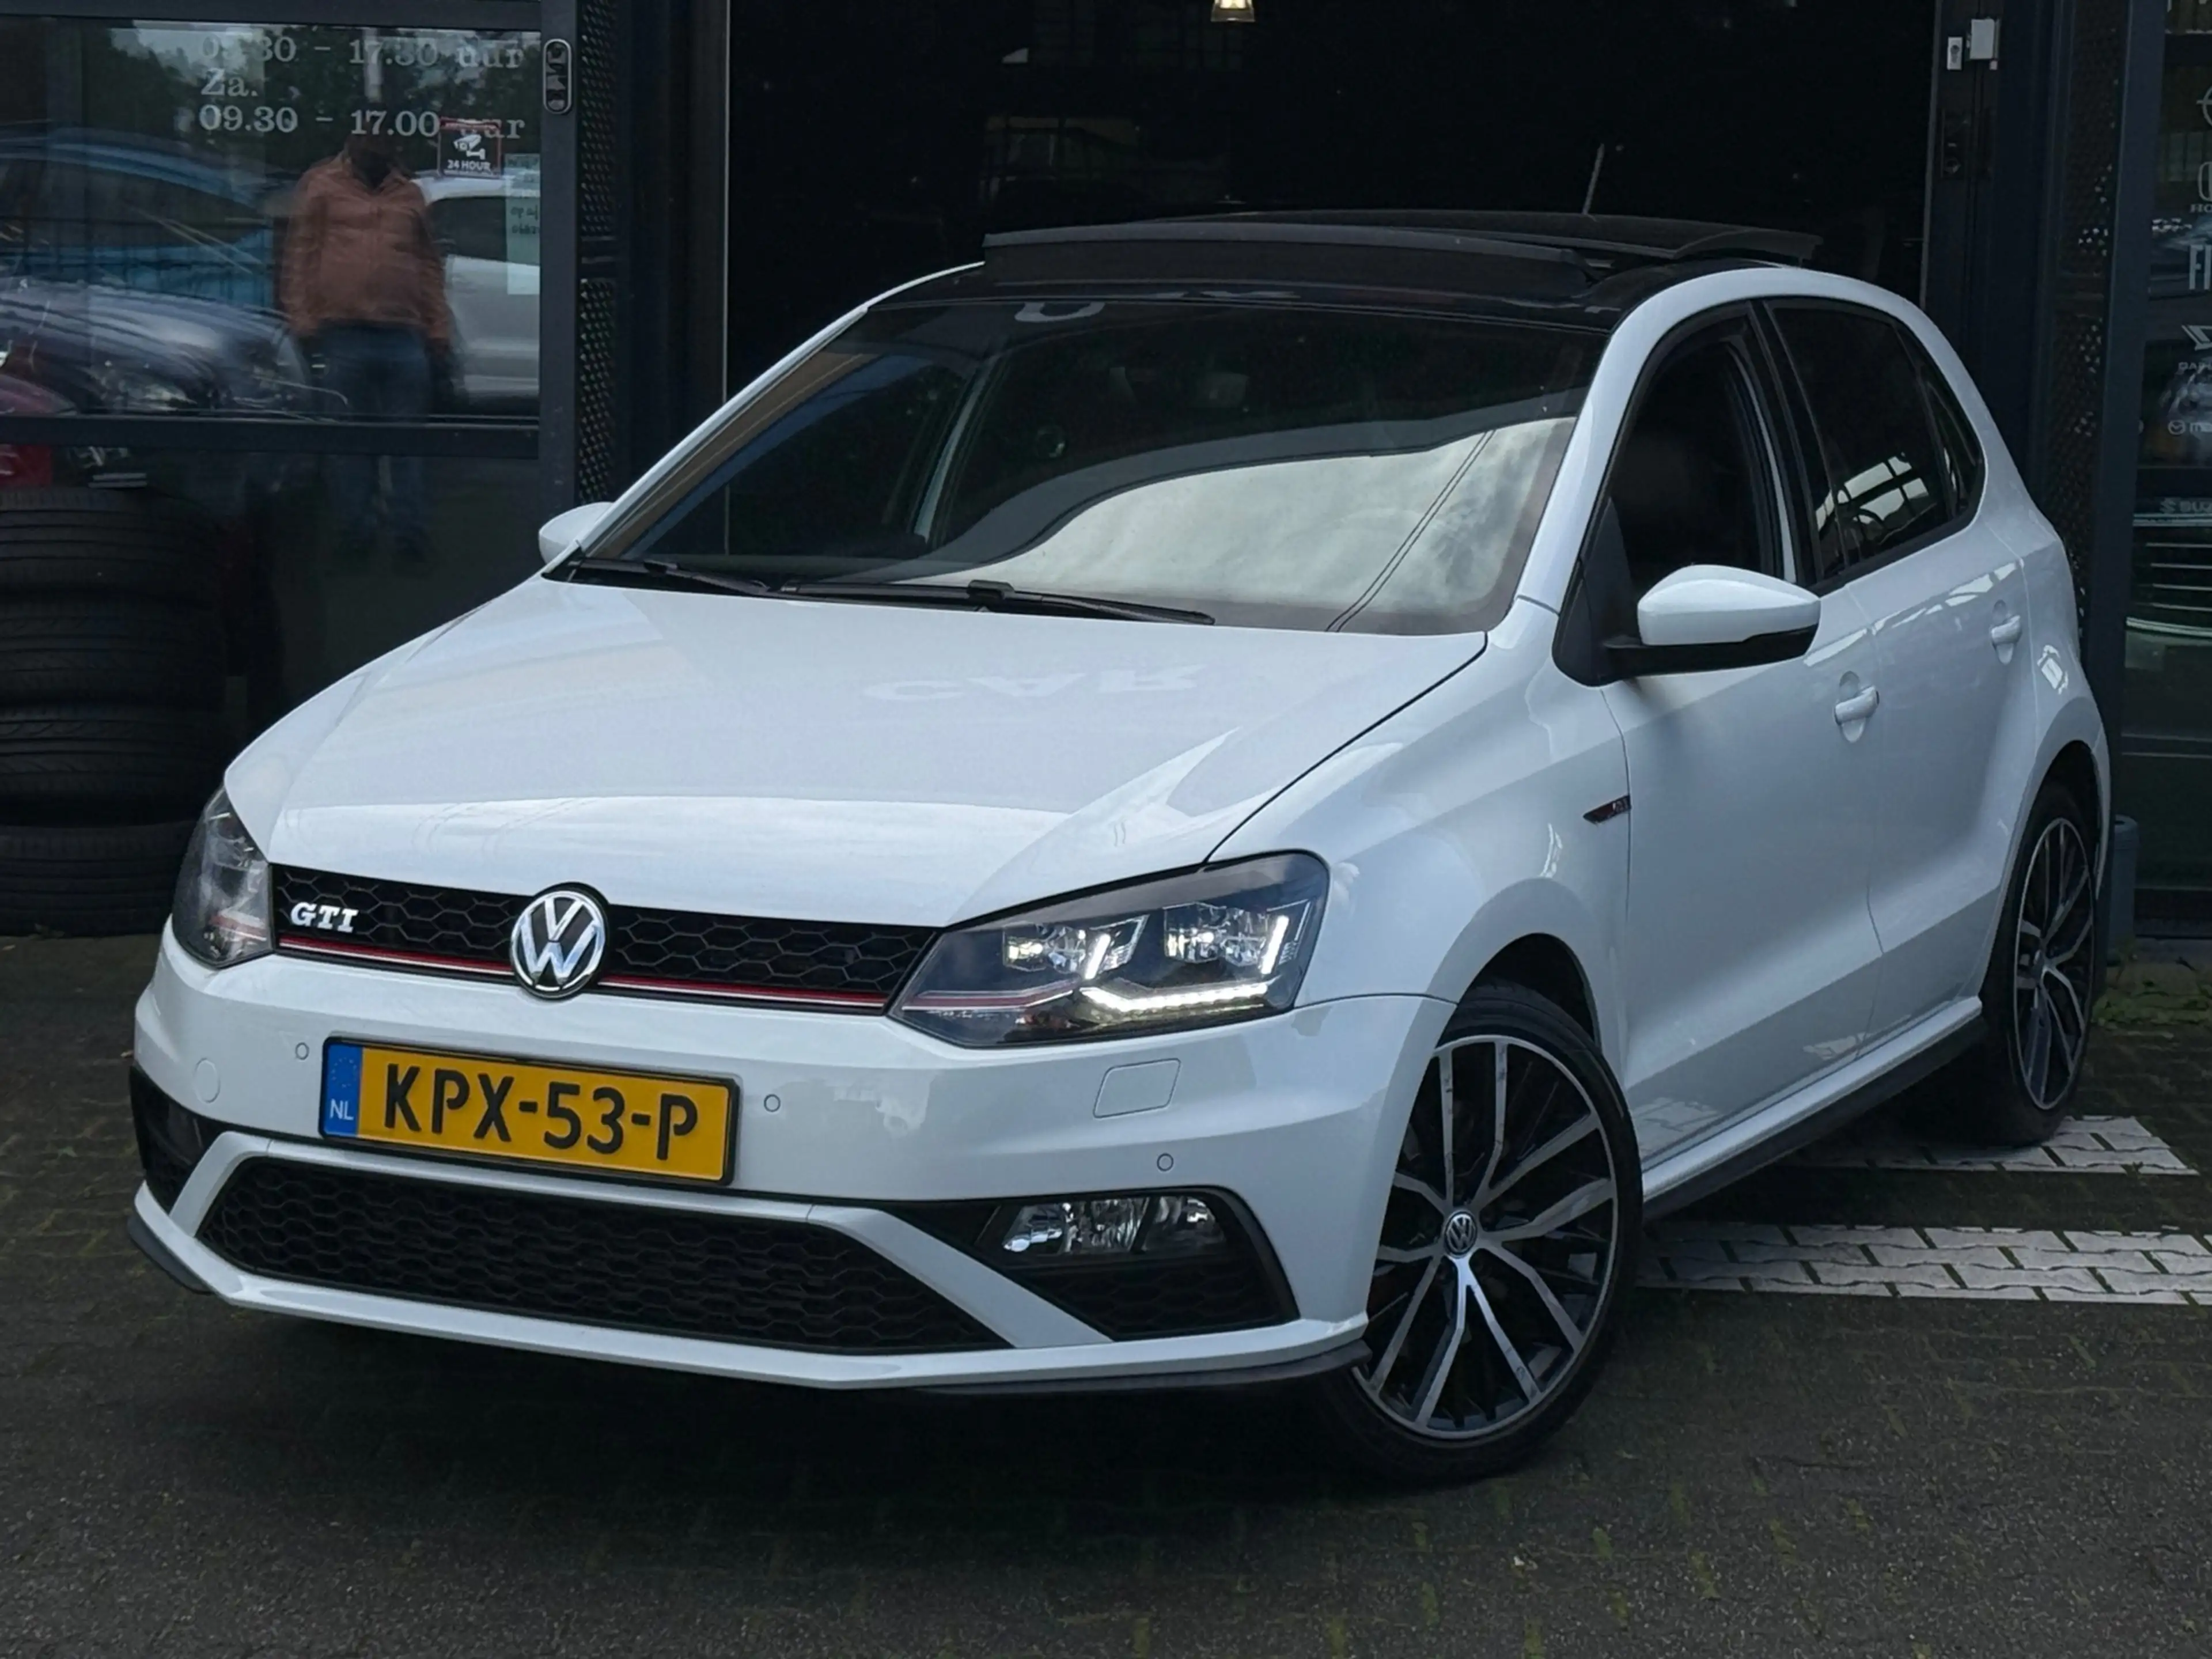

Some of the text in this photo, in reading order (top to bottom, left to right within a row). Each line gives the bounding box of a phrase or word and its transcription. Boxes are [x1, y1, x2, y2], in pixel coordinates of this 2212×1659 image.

[200, 67, 258, 97] Za.
[199, 104, 298, 133] 09.30
[350, 109, 440, 137] 17.00
[447, 160, 491, 172] 24 HOUR
[290, 902, 359, 933] GTI
[329, 1100, 354, 1120] NL
[384, 1063, 699, 1160] KPX-53-P
